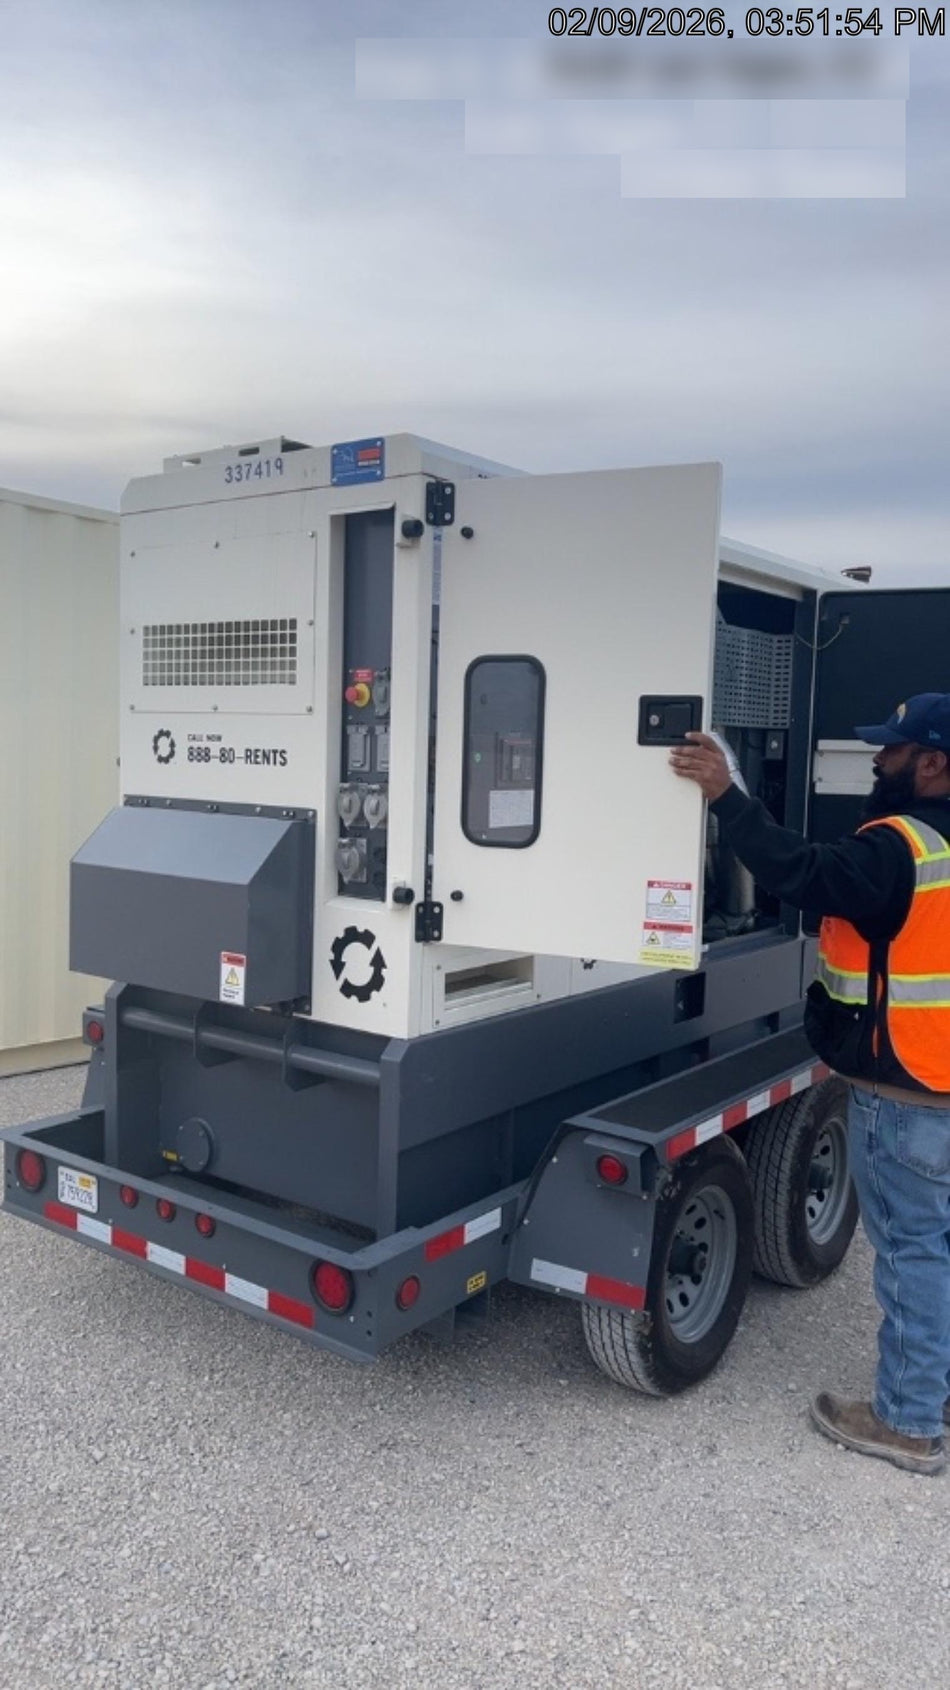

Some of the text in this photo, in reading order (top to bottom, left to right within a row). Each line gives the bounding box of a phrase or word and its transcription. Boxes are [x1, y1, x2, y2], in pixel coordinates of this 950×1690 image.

[224, 457, 284, 483] 337419
[187, 733, 222, 742] CALL NOW
[187, 746, 288, 766] 888-80-RENTS
